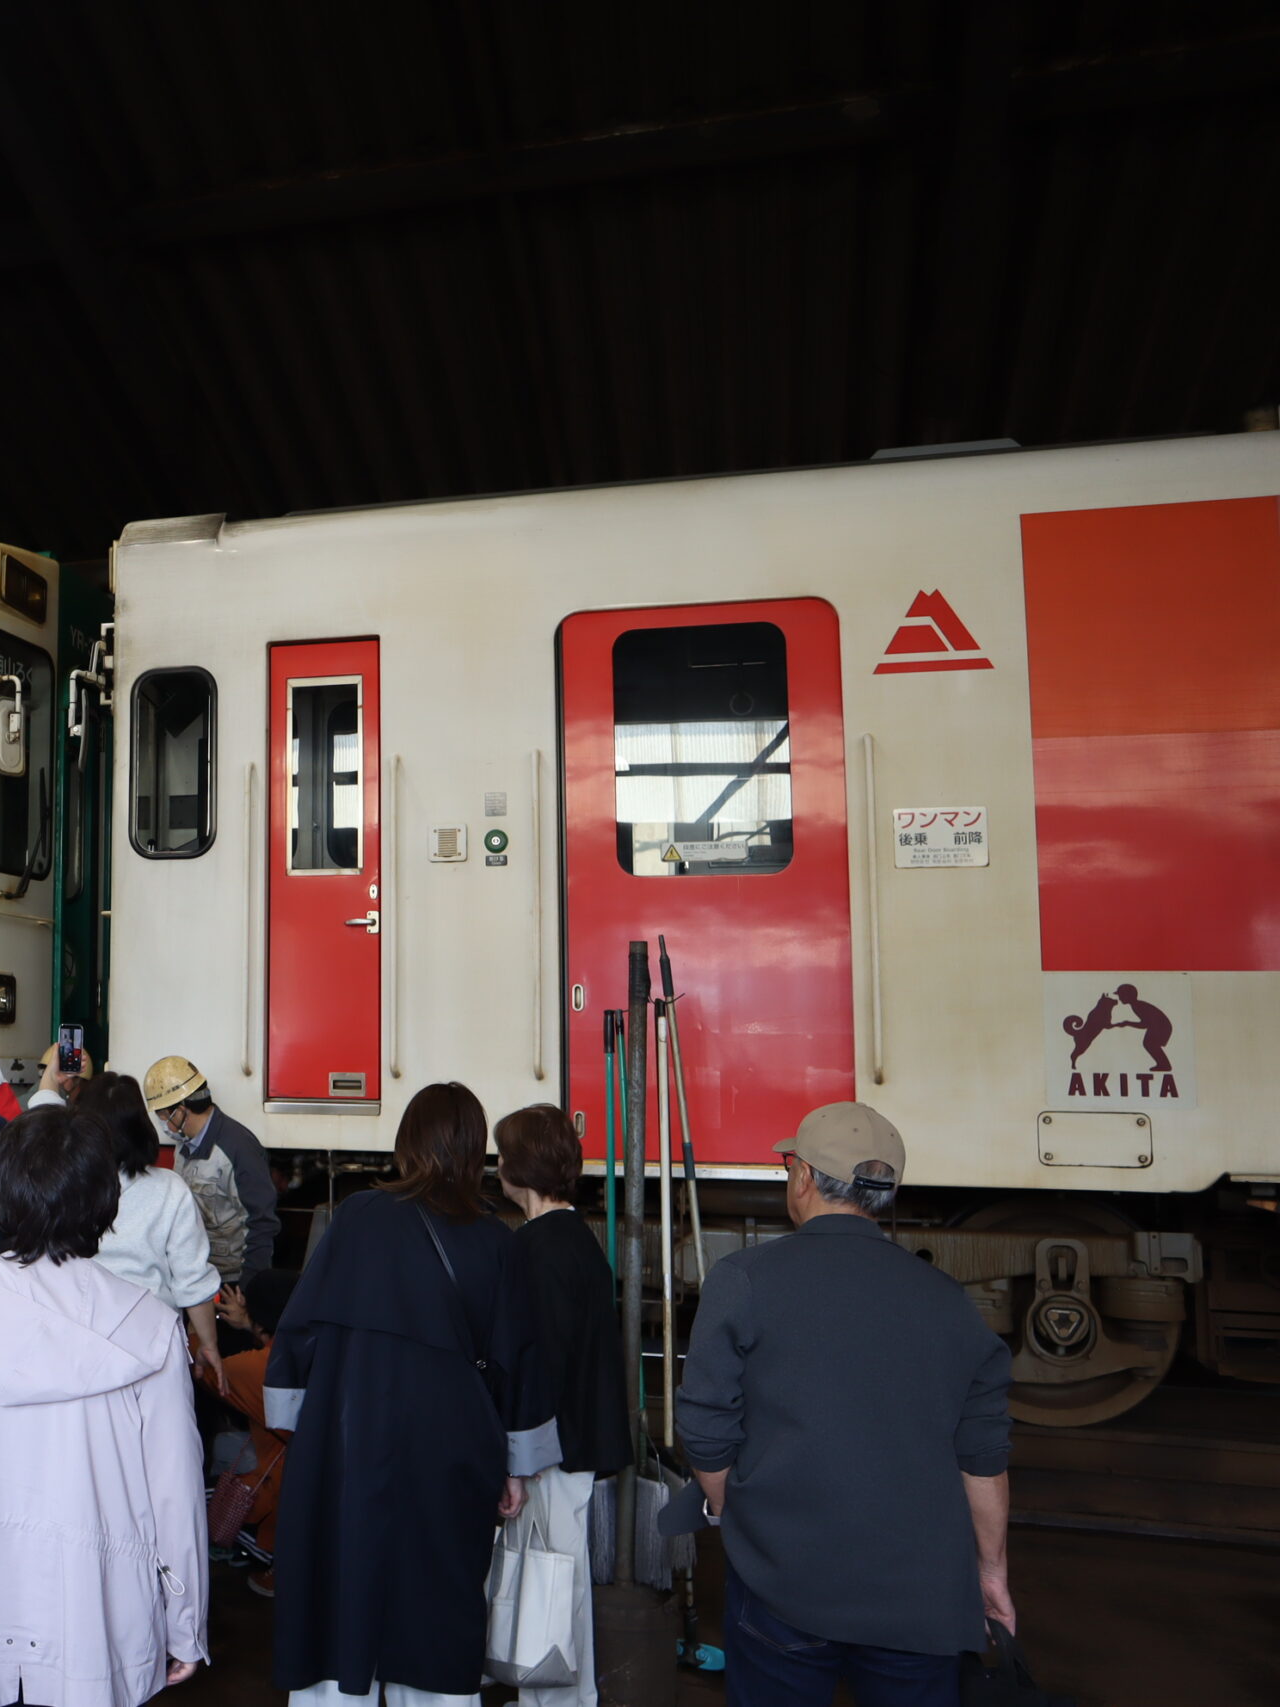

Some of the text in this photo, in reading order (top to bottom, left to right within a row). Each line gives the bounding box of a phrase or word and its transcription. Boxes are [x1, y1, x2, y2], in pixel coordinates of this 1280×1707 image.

[898, 811, 982, 829] ワンマン
[899, 831, 983, 847] 後乗 前降
[1068, 1072, 1179, 1098] AKITA
